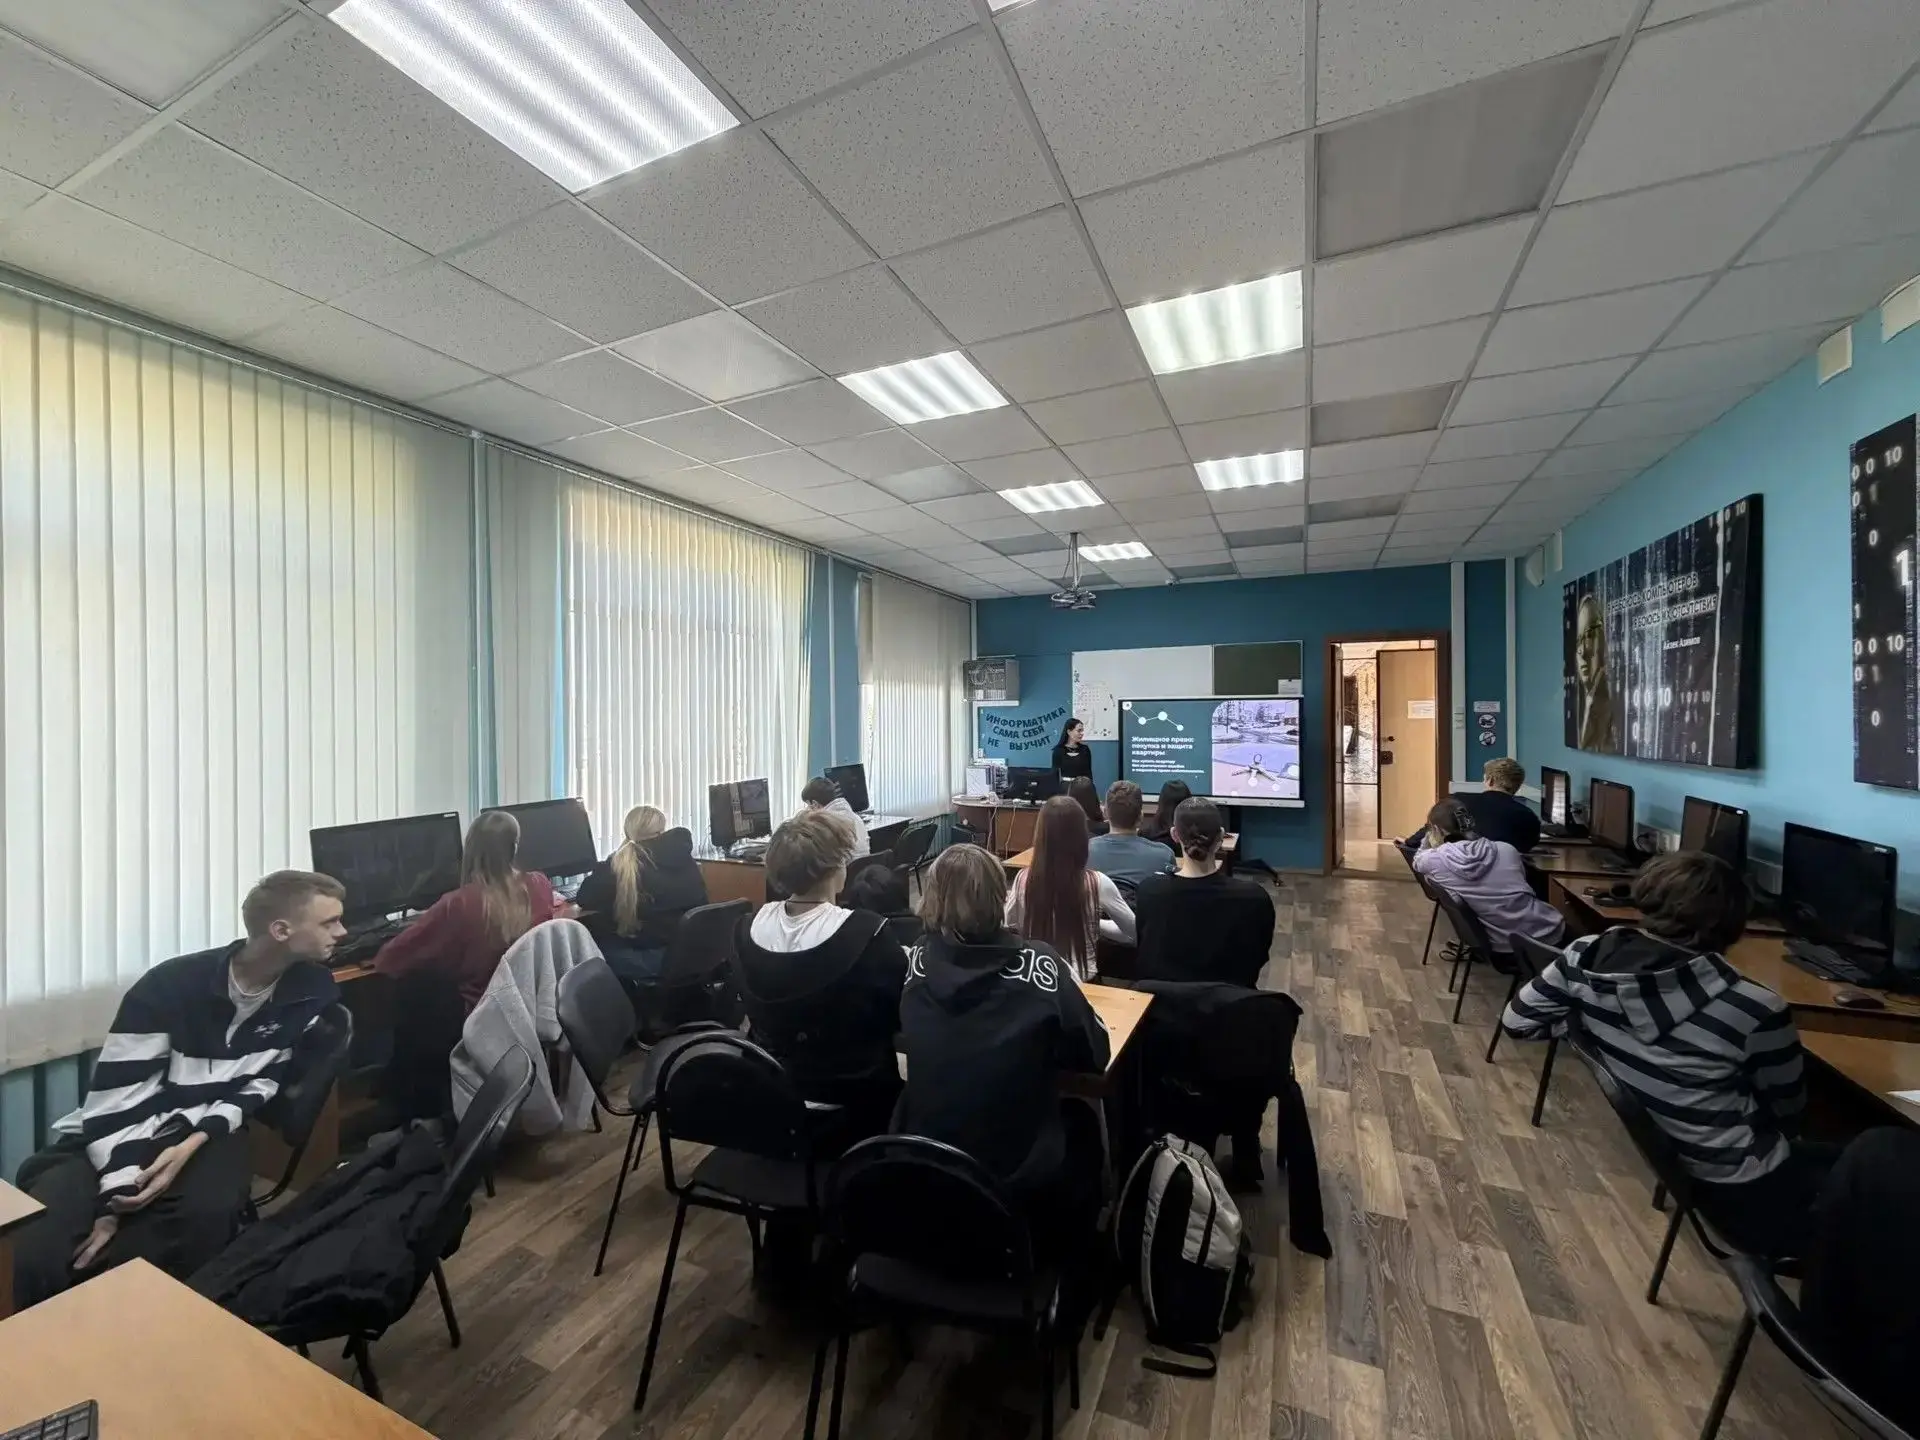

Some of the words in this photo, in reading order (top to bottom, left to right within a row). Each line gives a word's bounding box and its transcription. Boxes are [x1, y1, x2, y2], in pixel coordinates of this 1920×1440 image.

[1852, 464, 1860, 480] 0
[1866, 457, 1875, 474] 0
[1885, 446, 1902, 467] 10
[1852, 491, 1860, 507] 0
[1869, 529, 1878, 545] 0
[1896, 549, 1913, 586] 1
[1854, 640, 1863, 655] 0
[1868, 638, 1877, 653] 0
[1886, 634, 1904, 652] 10
[1855, 666, 1863, 682] 0
[986, 706, 1066, 729] ИНФОРМАТИКА
[1871, 710, 1880, 726] 0
[992, 725, 1020, 739] САМА
[1022, 725, 1045, 738] СЕБЯ
[987, 737, 1000, 748] НЕ
[1009, 735, 1051, 751] ВЫУЧИТ
